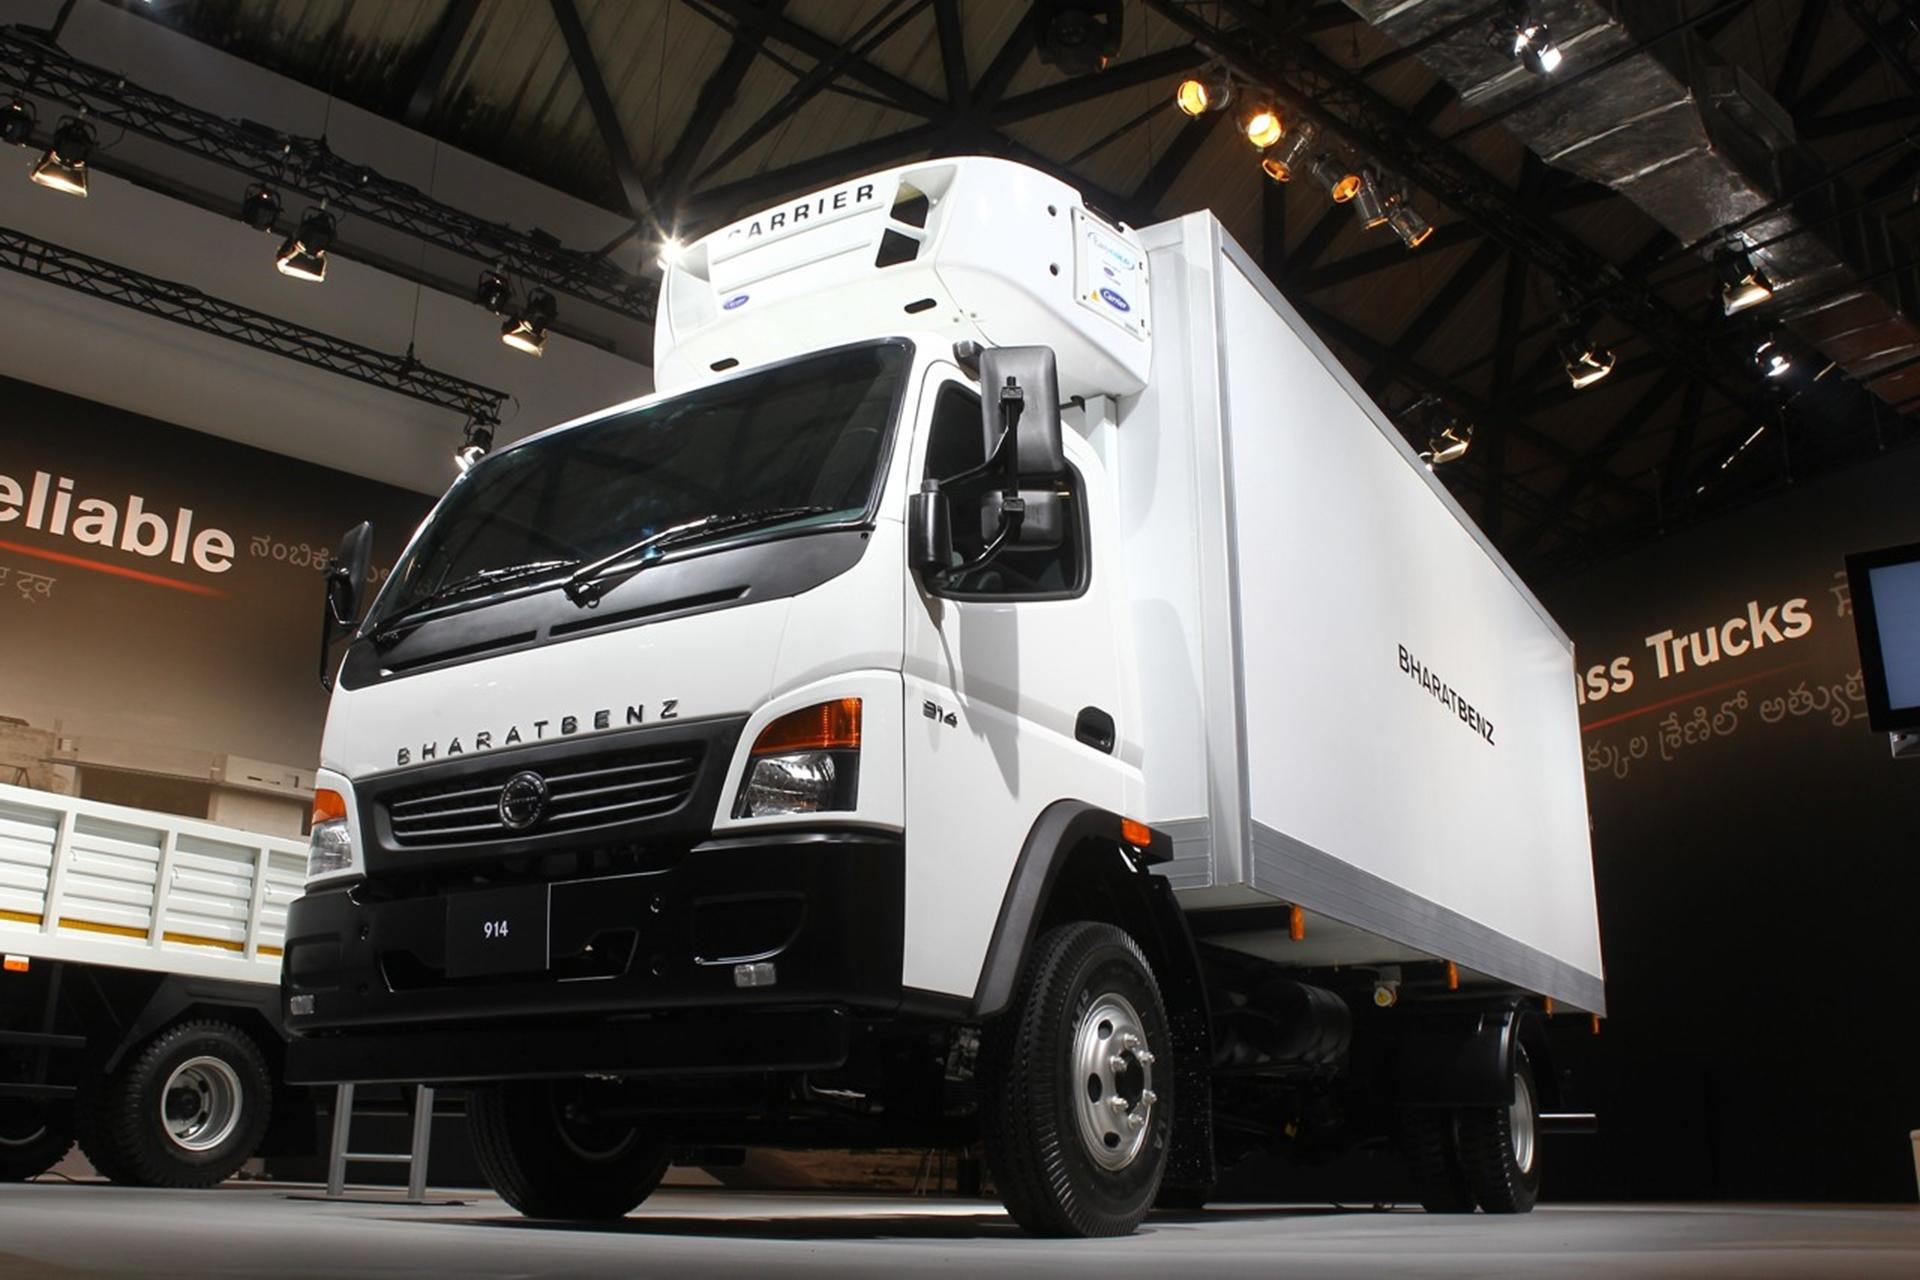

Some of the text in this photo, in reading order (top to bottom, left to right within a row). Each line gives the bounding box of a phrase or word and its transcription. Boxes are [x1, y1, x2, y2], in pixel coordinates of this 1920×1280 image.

[0, 470, 236, 574] eliable
[1645, 597, 1813, 679] Trucks
[396, 699, 679, 766] BHARATBENZ
[1398, 642, 1496, 747] BHARATBENZ
[483, 919, 509, 939] 914
